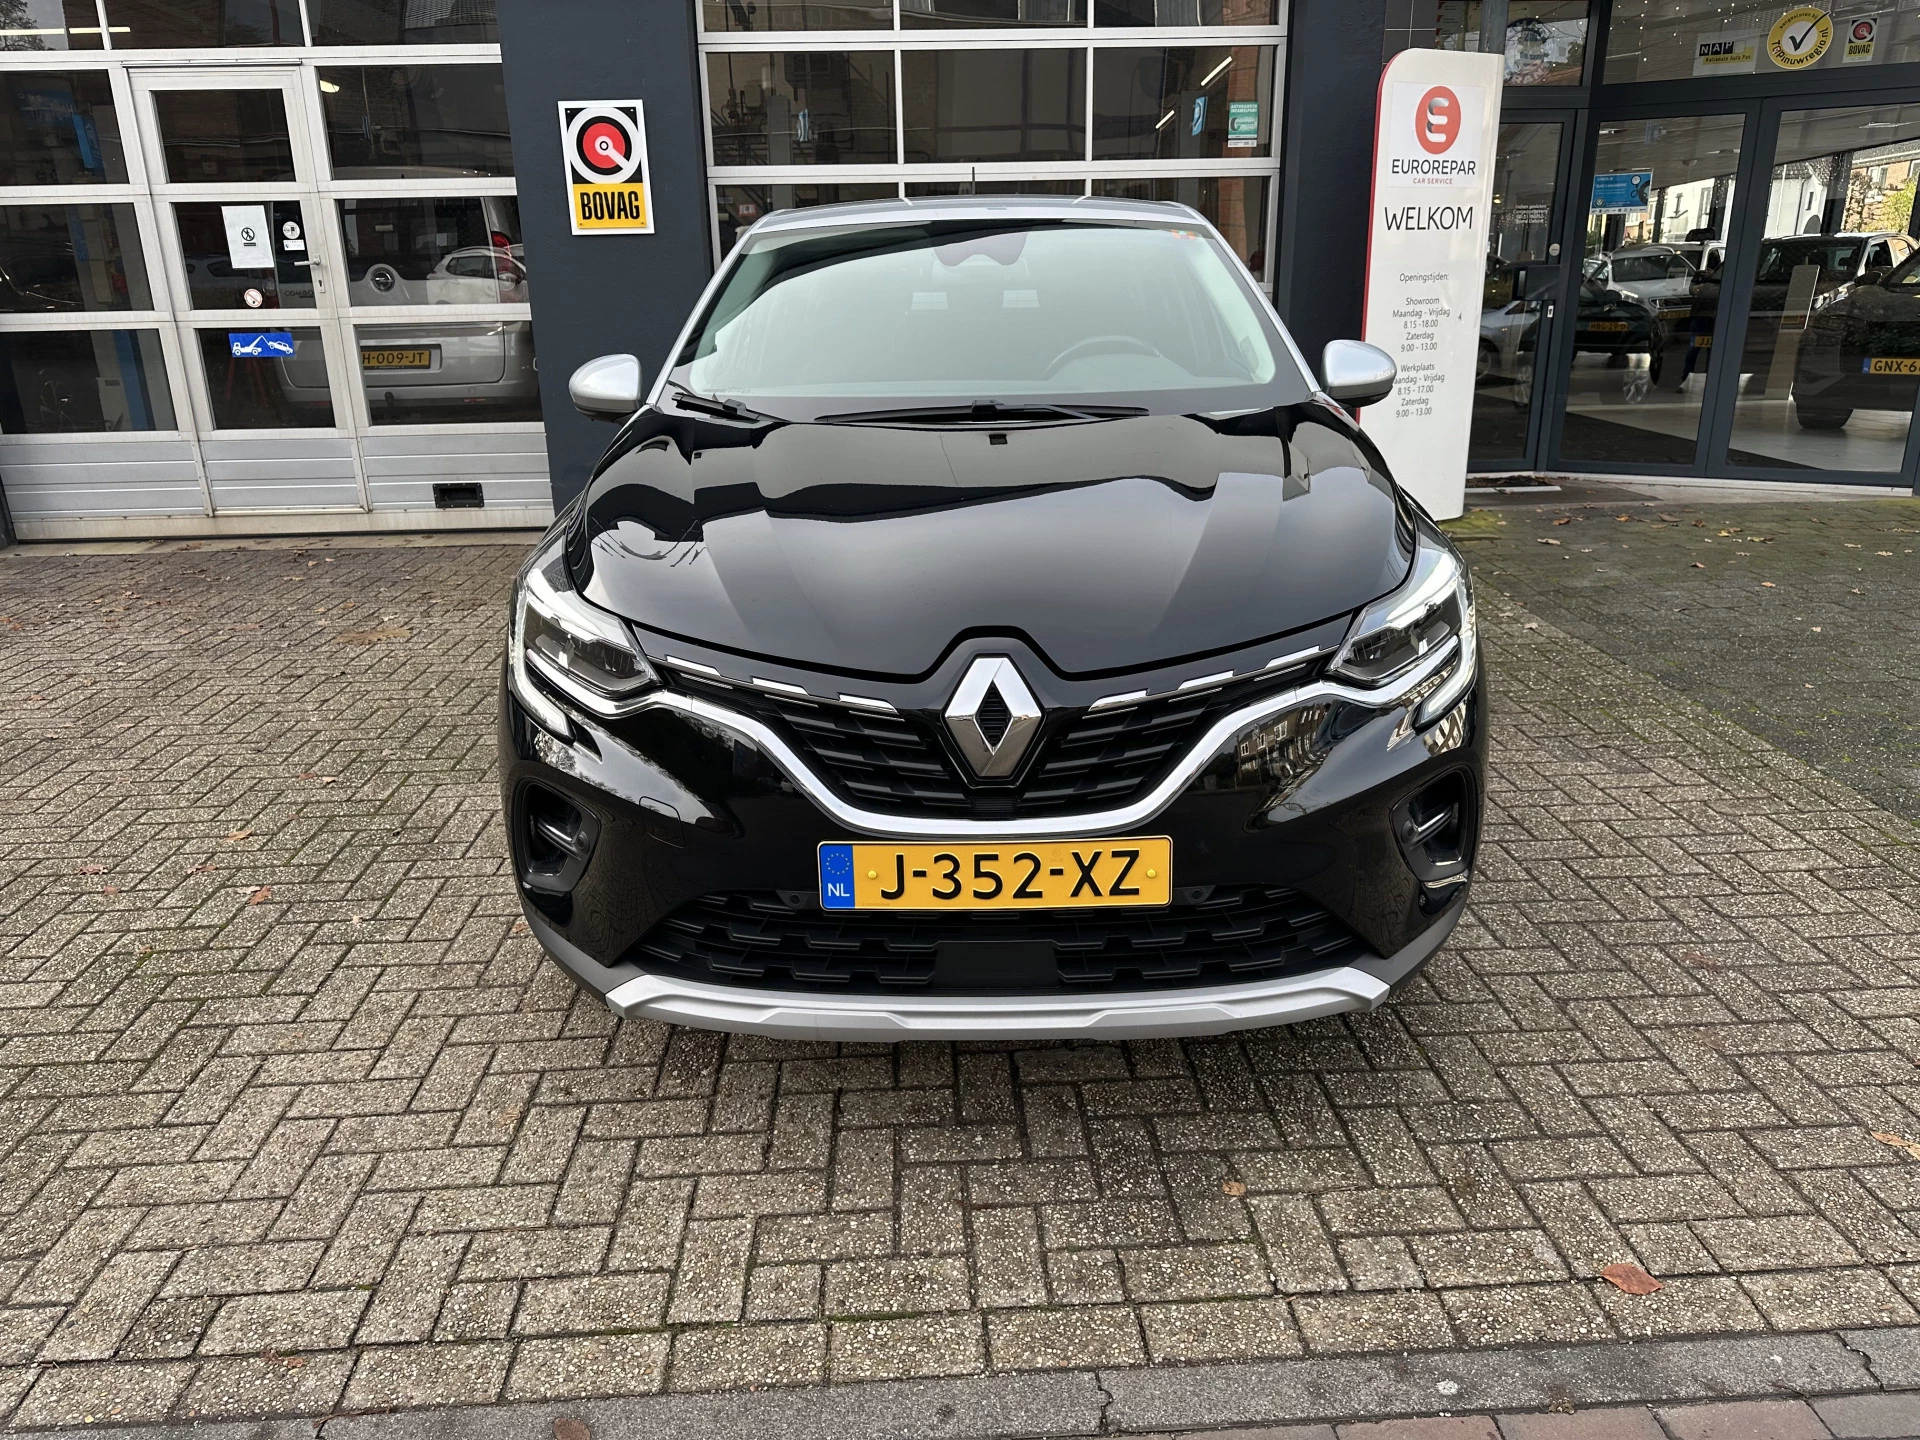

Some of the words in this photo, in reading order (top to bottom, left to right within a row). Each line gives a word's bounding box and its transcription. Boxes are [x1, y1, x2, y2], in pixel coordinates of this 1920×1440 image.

[1700, 40, 1734, 55] NAP
[1848, 43, 1872, 55] BOVAG
[1705, 55, 1729, 63] Nationale
[1391, 158, 1476, 175] EUROREPAR
[1412, 177, 1426, 185] CAR
[1427, 177, 1453, 185] SERVICE
[579, 190, 641, 221] BOVAG
[1384, 206, 1474, 231] WELKOM
[1399, 272, 1450, 284] Openingstijden:
[1405, 297, 1440, 306] Showroom
[1392, 309, 1423, 319] Maandag
[1428, 308, 1451, 318] Vrijdag
[1403, 320, 1417, 329] 8.15
[1405, 331, 1435, 342] Zaterdag
[1400, 343, 1415, 353] 9.00
[1420, 342, 1438, 351] 13.00
[362, 351, 425, 365] H-009-JT
[1400, 363, 1435, 373] Werkplaats
[1873, 359, 1920, 373] GNX-6
[1393, 376, 1418, 386] aandag
[1423, 374, 1445, 383] Vrijdag
[1397, 386, 1411, 396] 8.15
[1417, 385, 1434, 394] 17.00
[1400, 397, 1429, 407] Zaterdag
[1395, 409, 1410, 419] 9.00
[1415, 407, 1433, 417] 13.00
[880, 849, 1141, 901] J-352-XZ
[827, 882, 850, 897] NL
